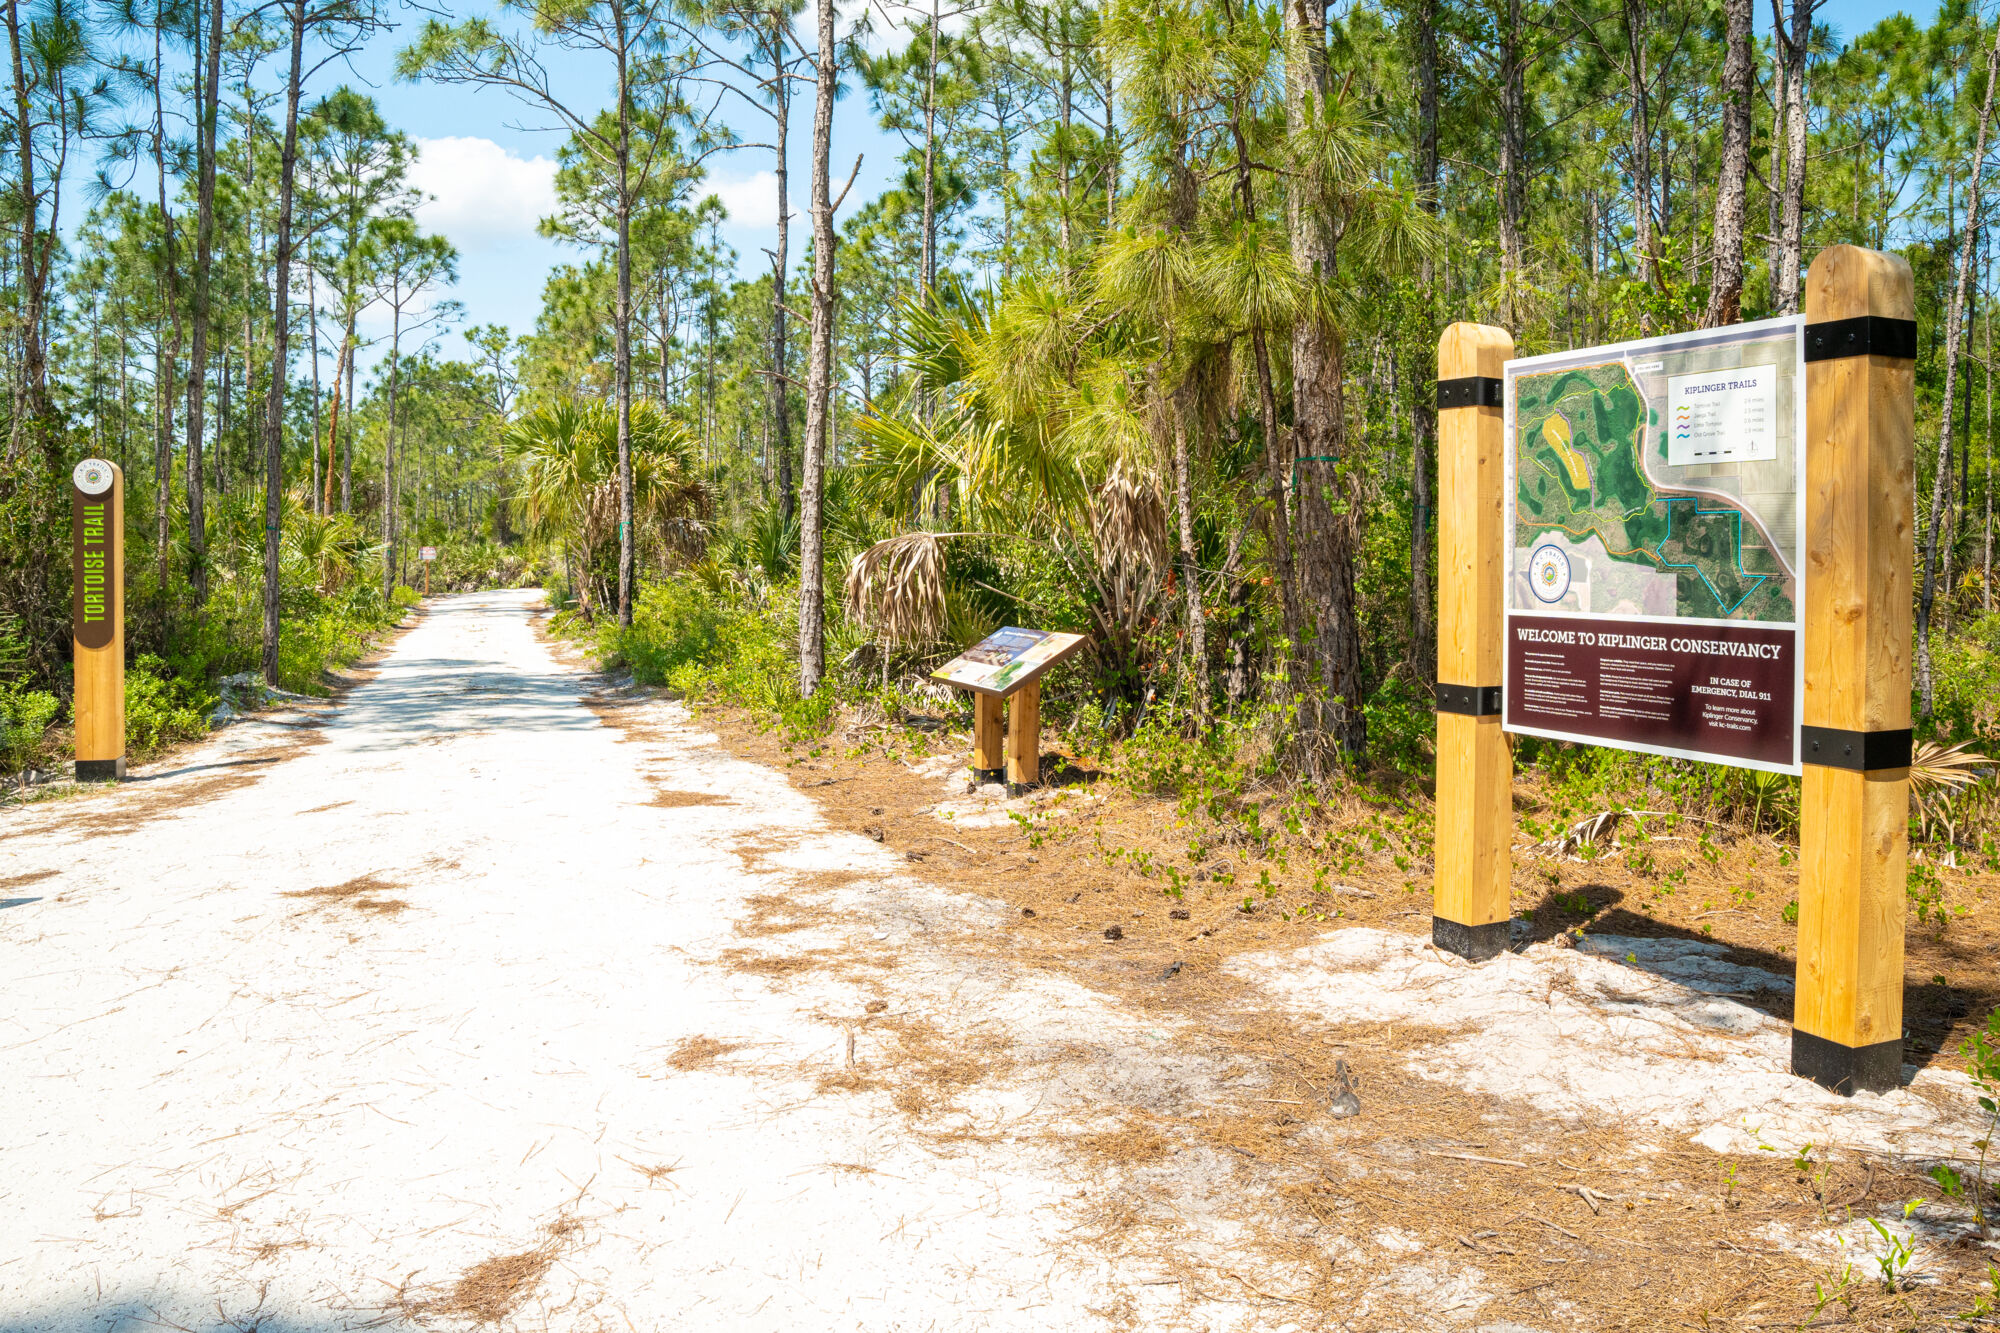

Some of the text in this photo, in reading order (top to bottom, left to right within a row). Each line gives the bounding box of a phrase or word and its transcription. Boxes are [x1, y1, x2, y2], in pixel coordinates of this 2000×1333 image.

[1684, 379, 1757, 395] KIPLINGER TRAILS
[84, 503, 104, 623] TORTOISE TRAIL
[1517, 628, 1781, 660] WELCOME TO KIPLINGER CONSERVANCY
[1709, 676, 1752, 689] IN CASE OF
[1691, 685, 1771, 701] EMERGENCY, DIAL 911
[1702, 711, 1723, 720] Kiplinger
[1725, 706, 1739, 714] more
[1740, 708, 1756, 716] about
